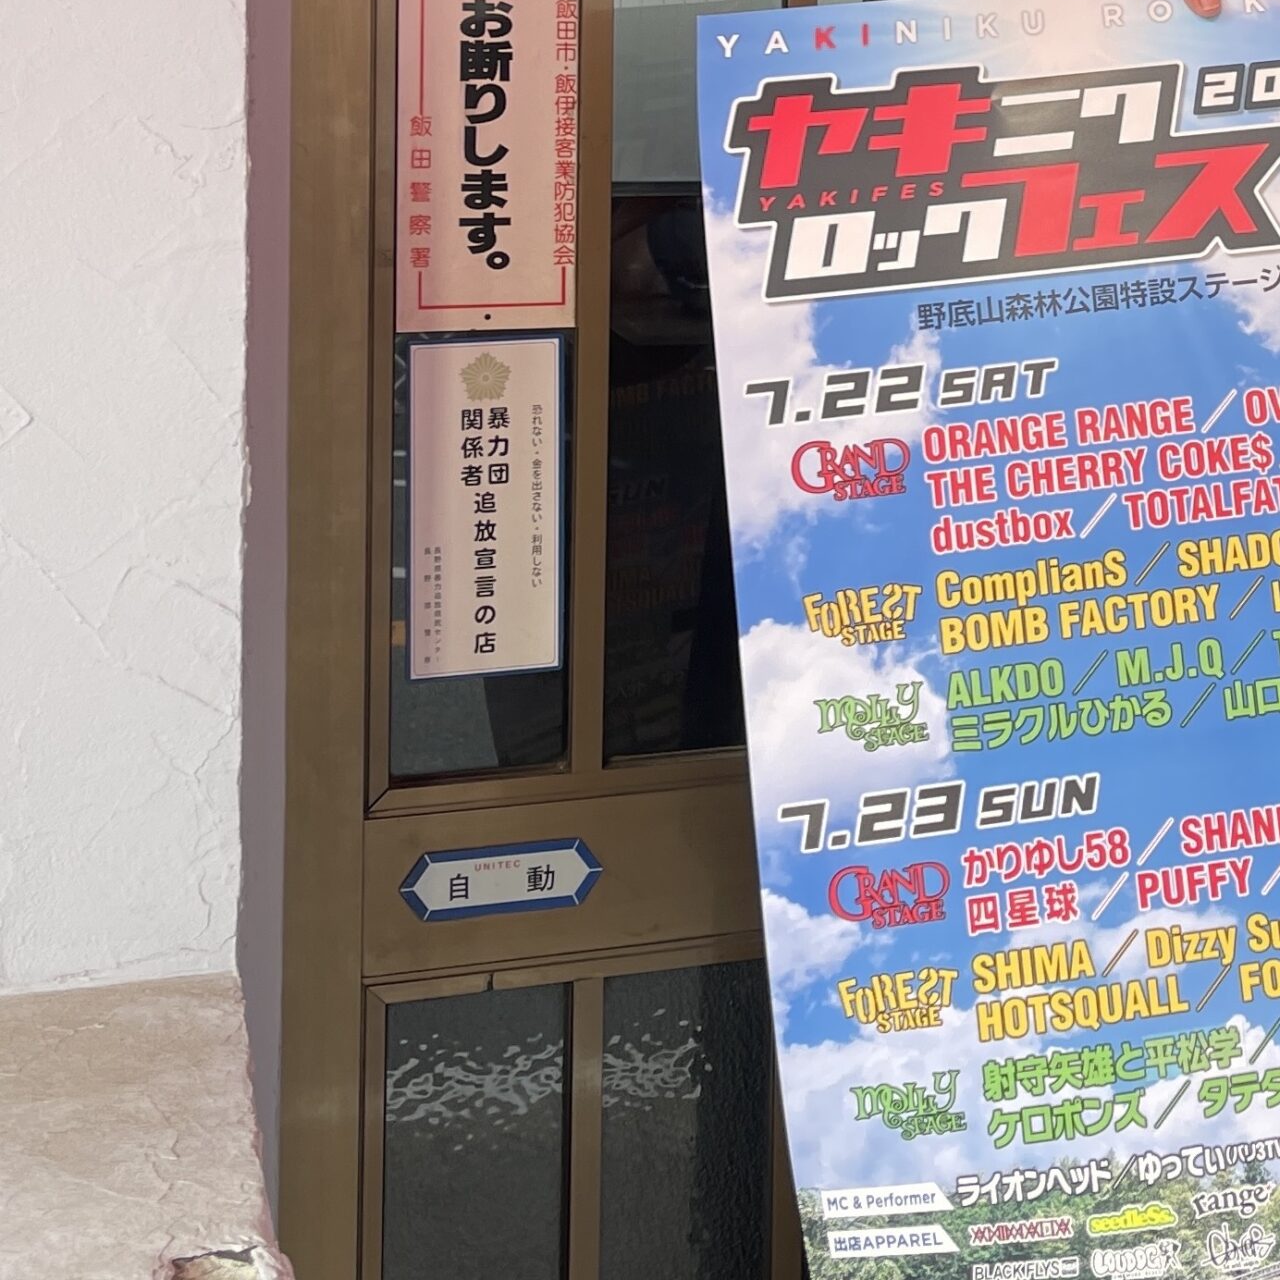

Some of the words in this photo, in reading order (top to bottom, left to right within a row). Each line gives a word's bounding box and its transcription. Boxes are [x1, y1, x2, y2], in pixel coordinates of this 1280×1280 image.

[717, 10, 1044, 58] YAKINIKU
[748, 81, 1162, 189] ヤキニク
[410, 116, 432, 268] 飯田警察署
[759, 182, 944, 212] YAKIFES
[784, 143, 1270, 280] ロックフェス
[745, 366, 923, 425] 7.22
[940, 359, 1058, 407] SAT
[461, 408, 484, 487] 関係者
[488, 407, 510, 485] 暴力団
[923, 413, 1065, 462] ORANGE
[1077, 397, 1194, 451] RANGE
[791, 438, 910, 494] GRAND
[834, 477, 906, 501] STAGE
[927, 469, 997, 507] THE
[1007, 445, 1148, 494] CHERRY
[932, 508, 1073, 553] dustbox
[473, 491, 497, 654] 追放宣言の店
[935, 550, 1127, 609] ComplianS
[840, 621, 907, 647] STAGE
[940, 608, 1049, 654] BOMB
[1059, 583, 1221, 639] FACTORY
[947, 659, 1064, 710] ALKDO
[1116, 638, 1224, 688] M.J.Q
[864, 722, 929, 752] STAGE
[951, 689, 1172, 751] ミラクルひかる
[779, 781, 965, 852] 7.23
[977, 773, 1100, 829] SUN
[449, 864, 555, 901] 自動
[474, 860, 521, 872] UNITEC
[963, 827, 1130, 887] かりゆし58
[828, 861, 950, 922] GRAND
[871, 901, 947, 929] STAGE
[966, 883, 1079, 936] 四星球
[1136, 858, 1252, 910] PUFFY
[971, 939, 1095, 995] SHIMA
[1145, 923, 1237, 969] Dizzy
[877, 1006, 943, 1033] STAGE
[977, 975, 1190, 1042] HOTSQUALL
[900, 1110, 967, 1140] STAGE
[988, 1088, 1148, 1148] ケロポンズ
[827, 1197, 848, 1211] MC
[853, 1195, 863, 1210] &
[867, 1192, 936, 1208] Performer
[956, 1158, 1112, 1207] ライオンヘッド
[1193, 1185, 1268, 1216] range
[833, 1232, 943, 1252] 出店APPAREL
